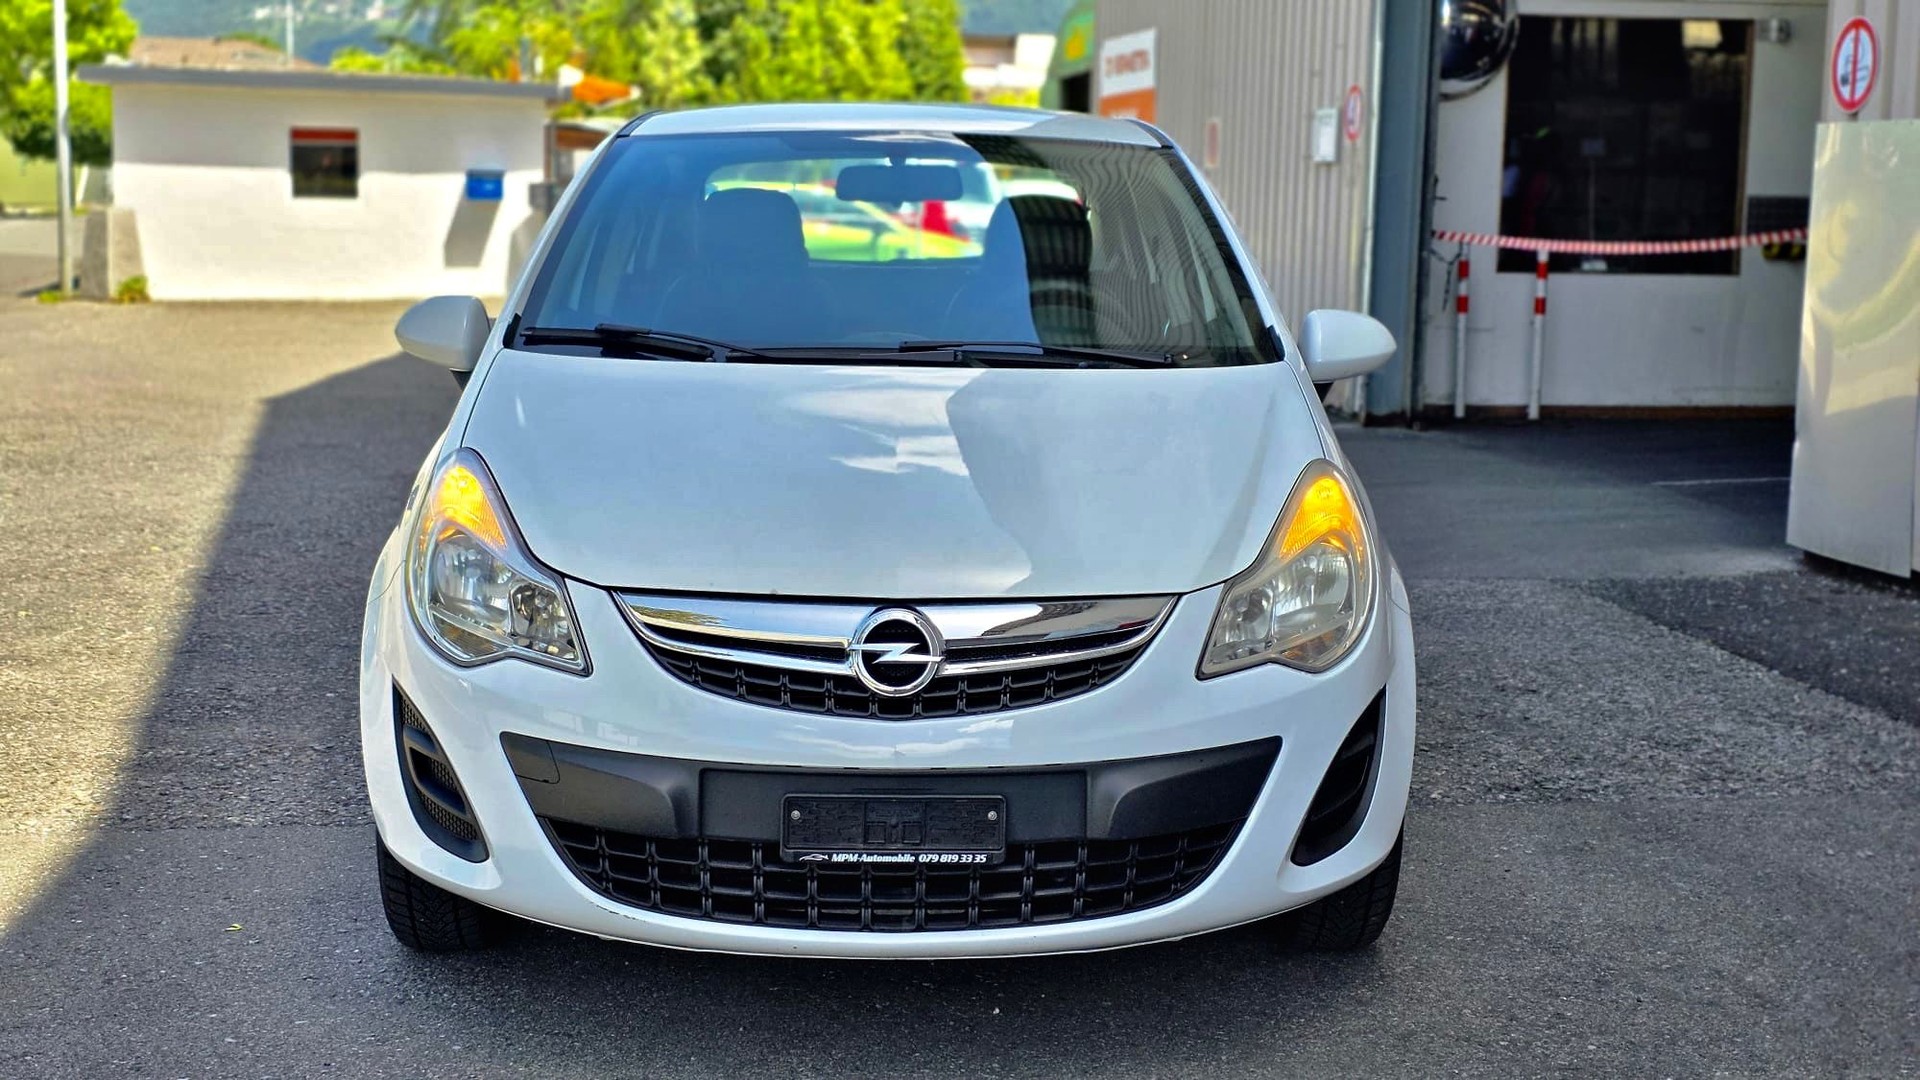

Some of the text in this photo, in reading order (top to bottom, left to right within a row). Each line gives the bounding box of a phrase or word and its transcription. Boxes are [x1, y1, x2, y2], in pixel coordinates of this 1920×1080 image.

[831, 853, 988, 863] MPM-Automobile 079 819 33 35
